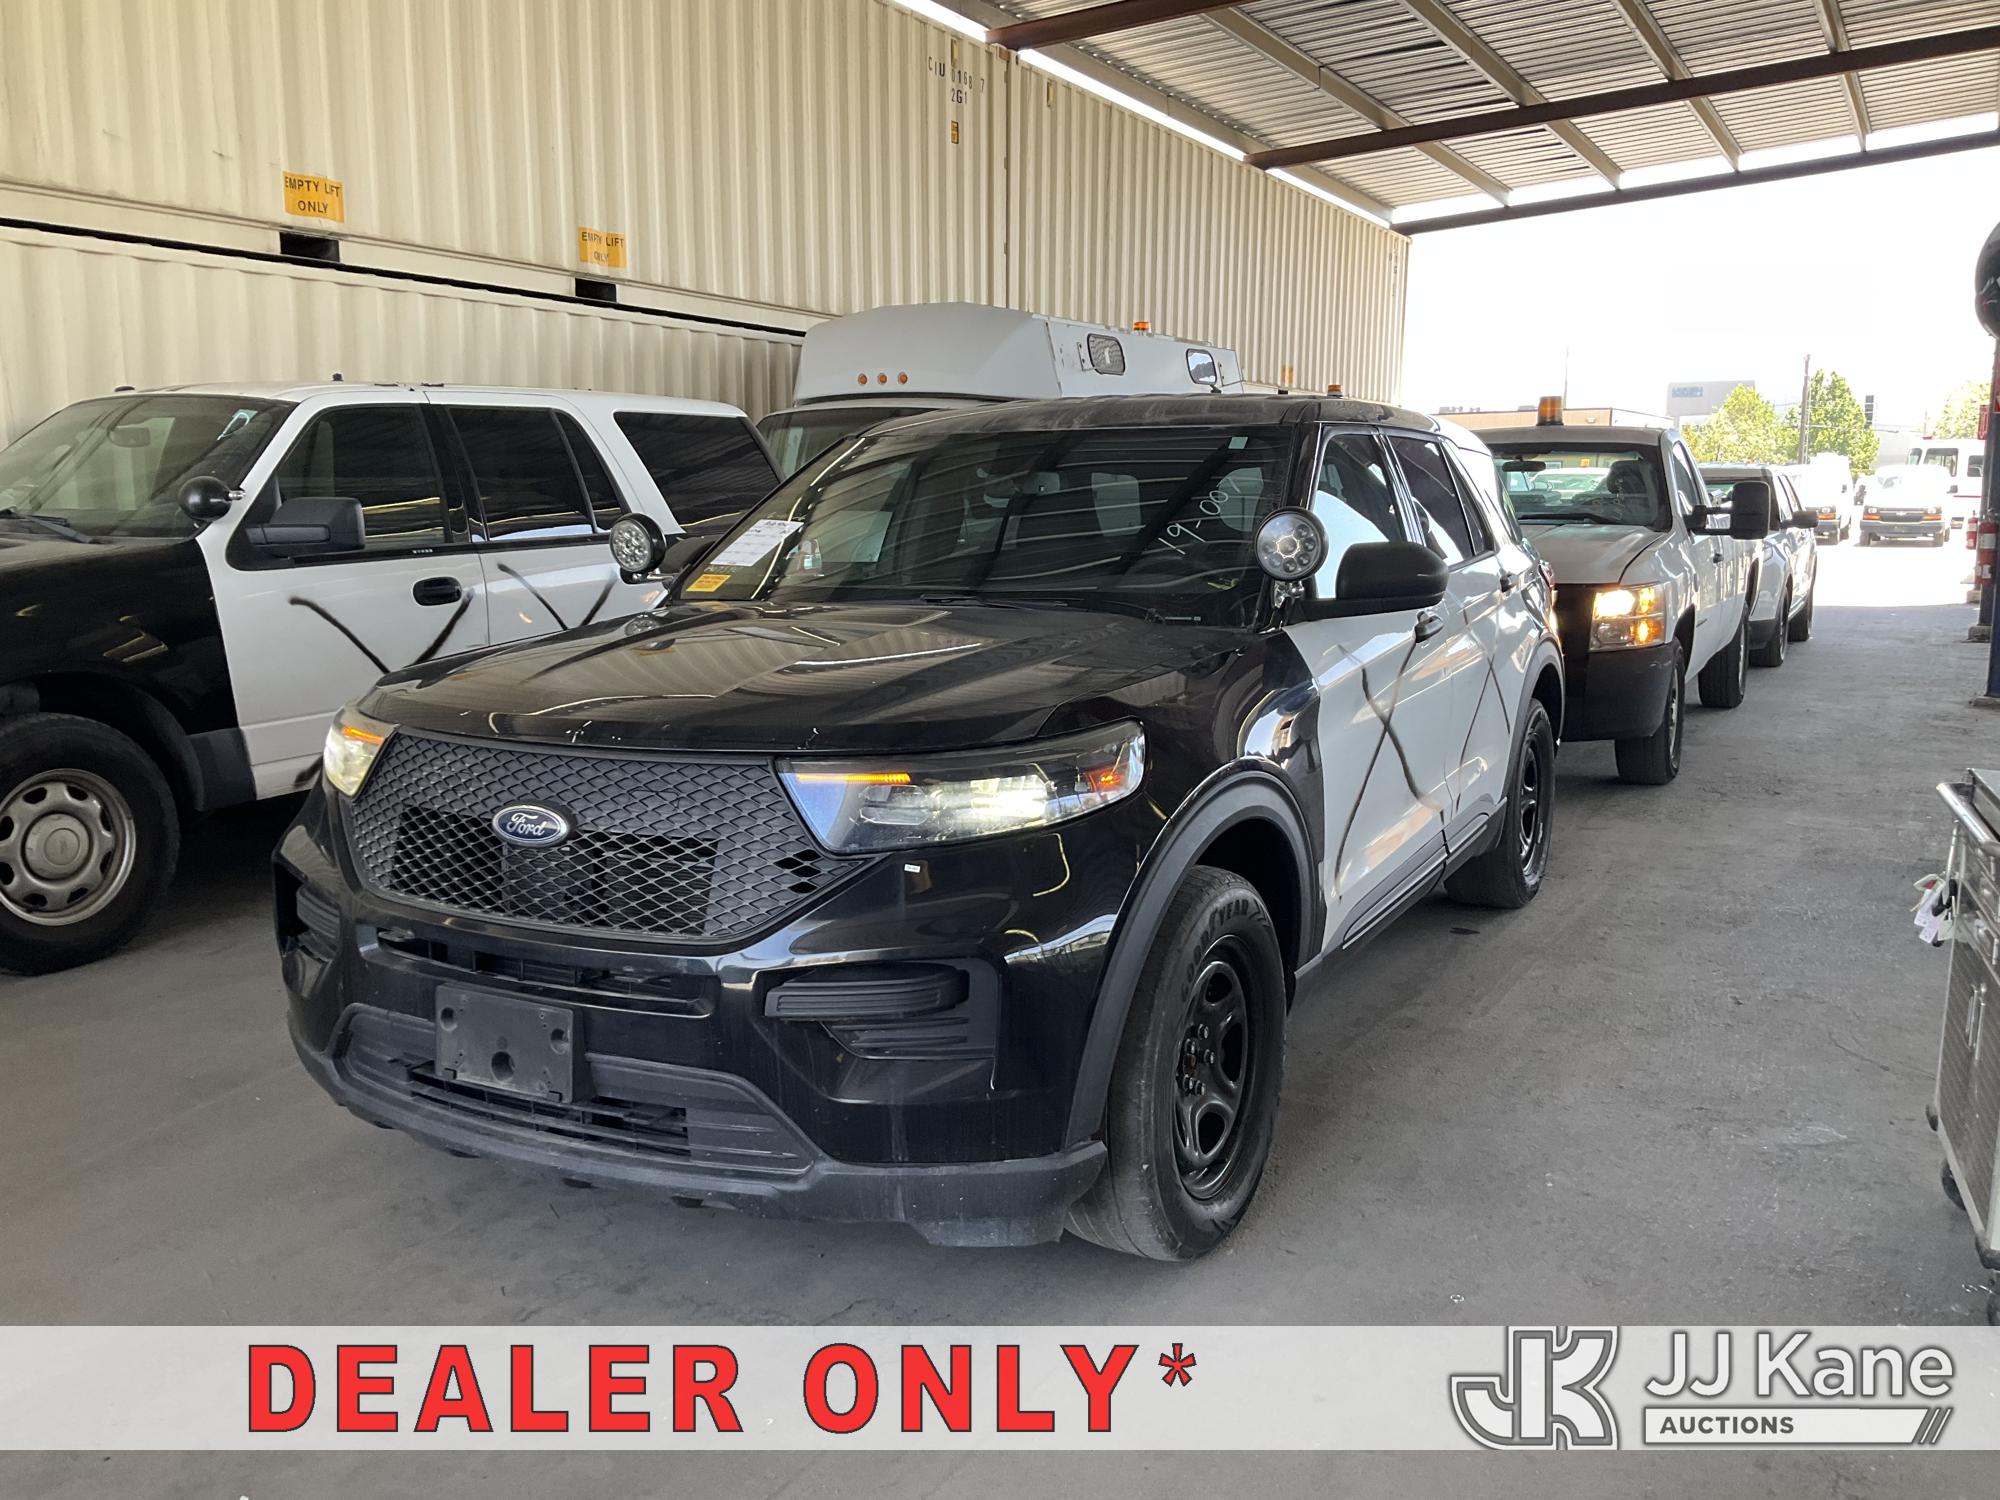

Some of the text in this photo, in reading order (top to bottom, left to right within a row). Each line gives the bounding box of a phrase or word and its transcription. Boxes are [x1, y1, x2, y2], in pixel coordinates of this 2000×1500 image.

[285, 176, 319, 192] EMPTY
[297, 200, 328, 213] ONLY
[606, 237, 624, 248] LIFT
[506, 812, 548, 836] Ford
